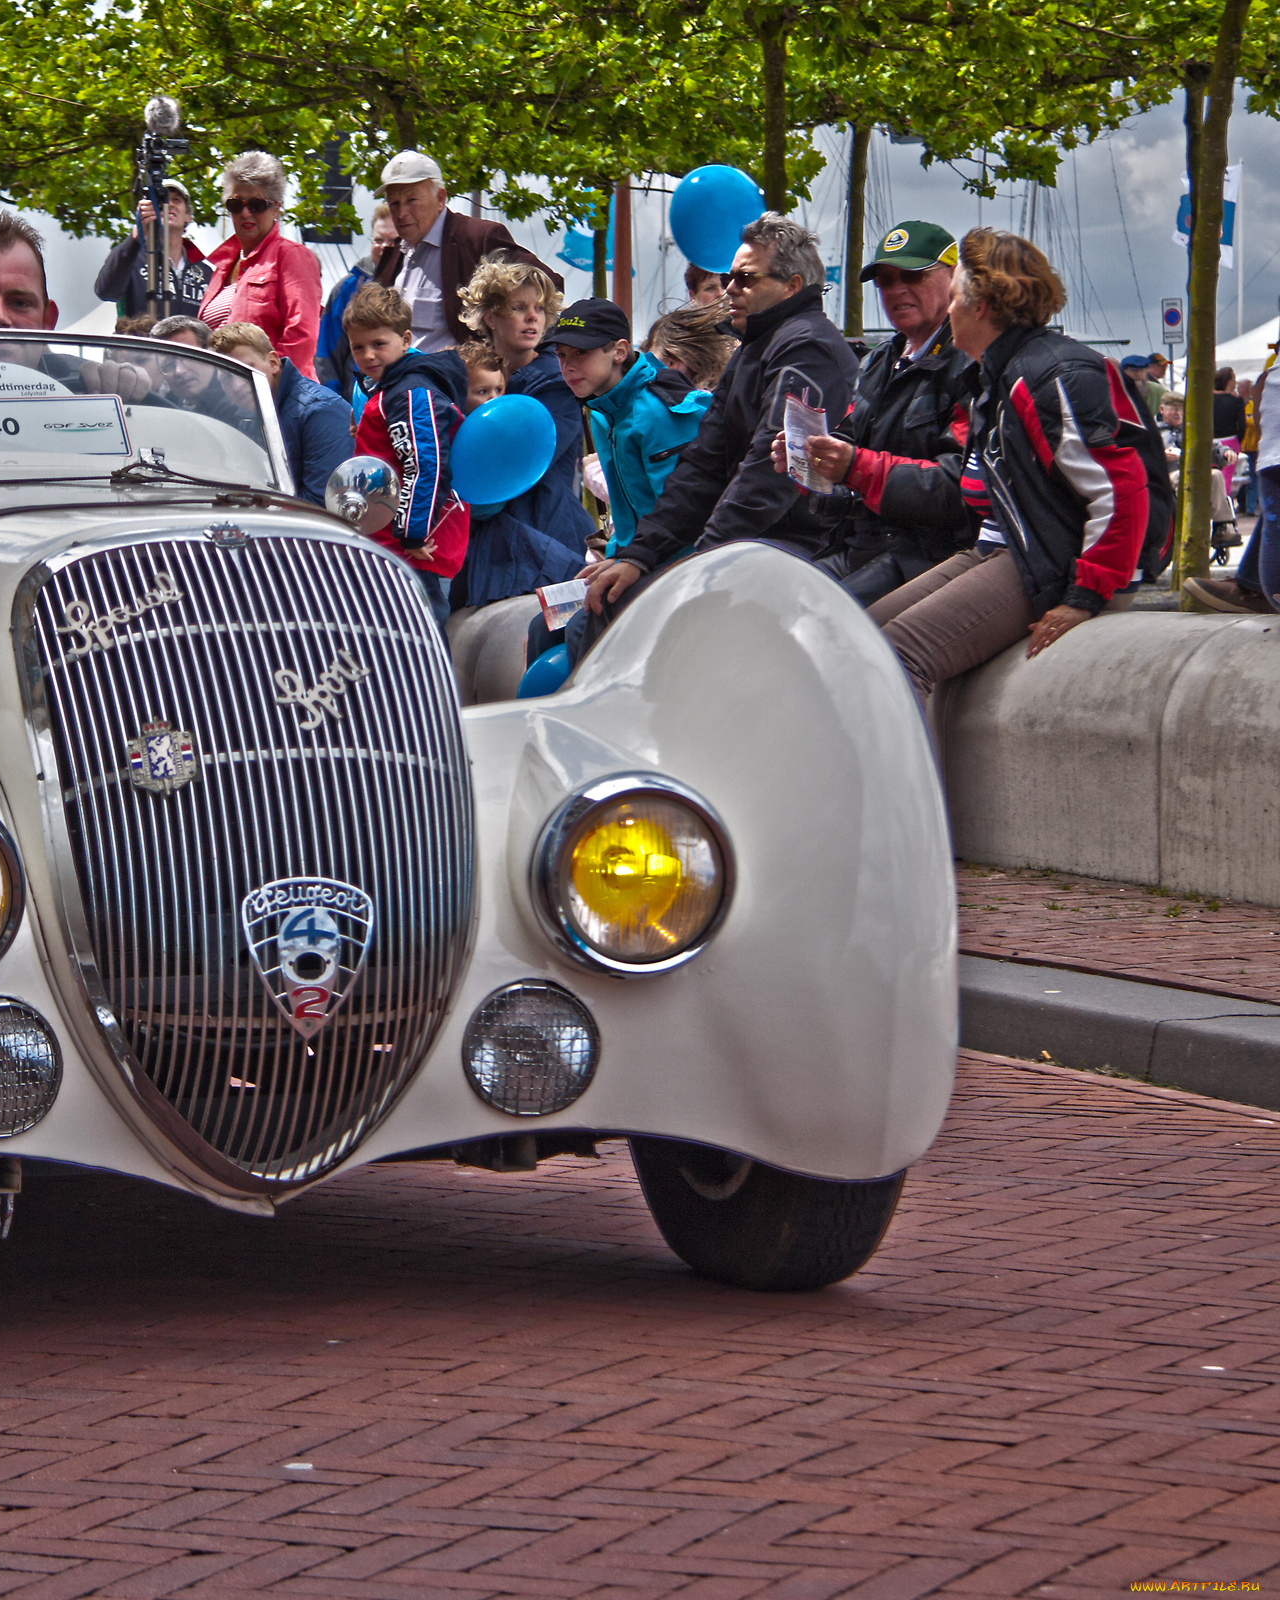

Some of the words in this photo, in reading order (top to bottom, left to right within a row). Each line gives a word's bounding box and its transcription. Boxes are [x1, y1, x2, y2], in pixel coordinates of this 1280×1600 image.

[274, 648, 371, 730] Sport
[248, 884, 370, 915] Peugeot
[283, 908, 336, 945] 4
[291, 986, 329, 1019] 2
